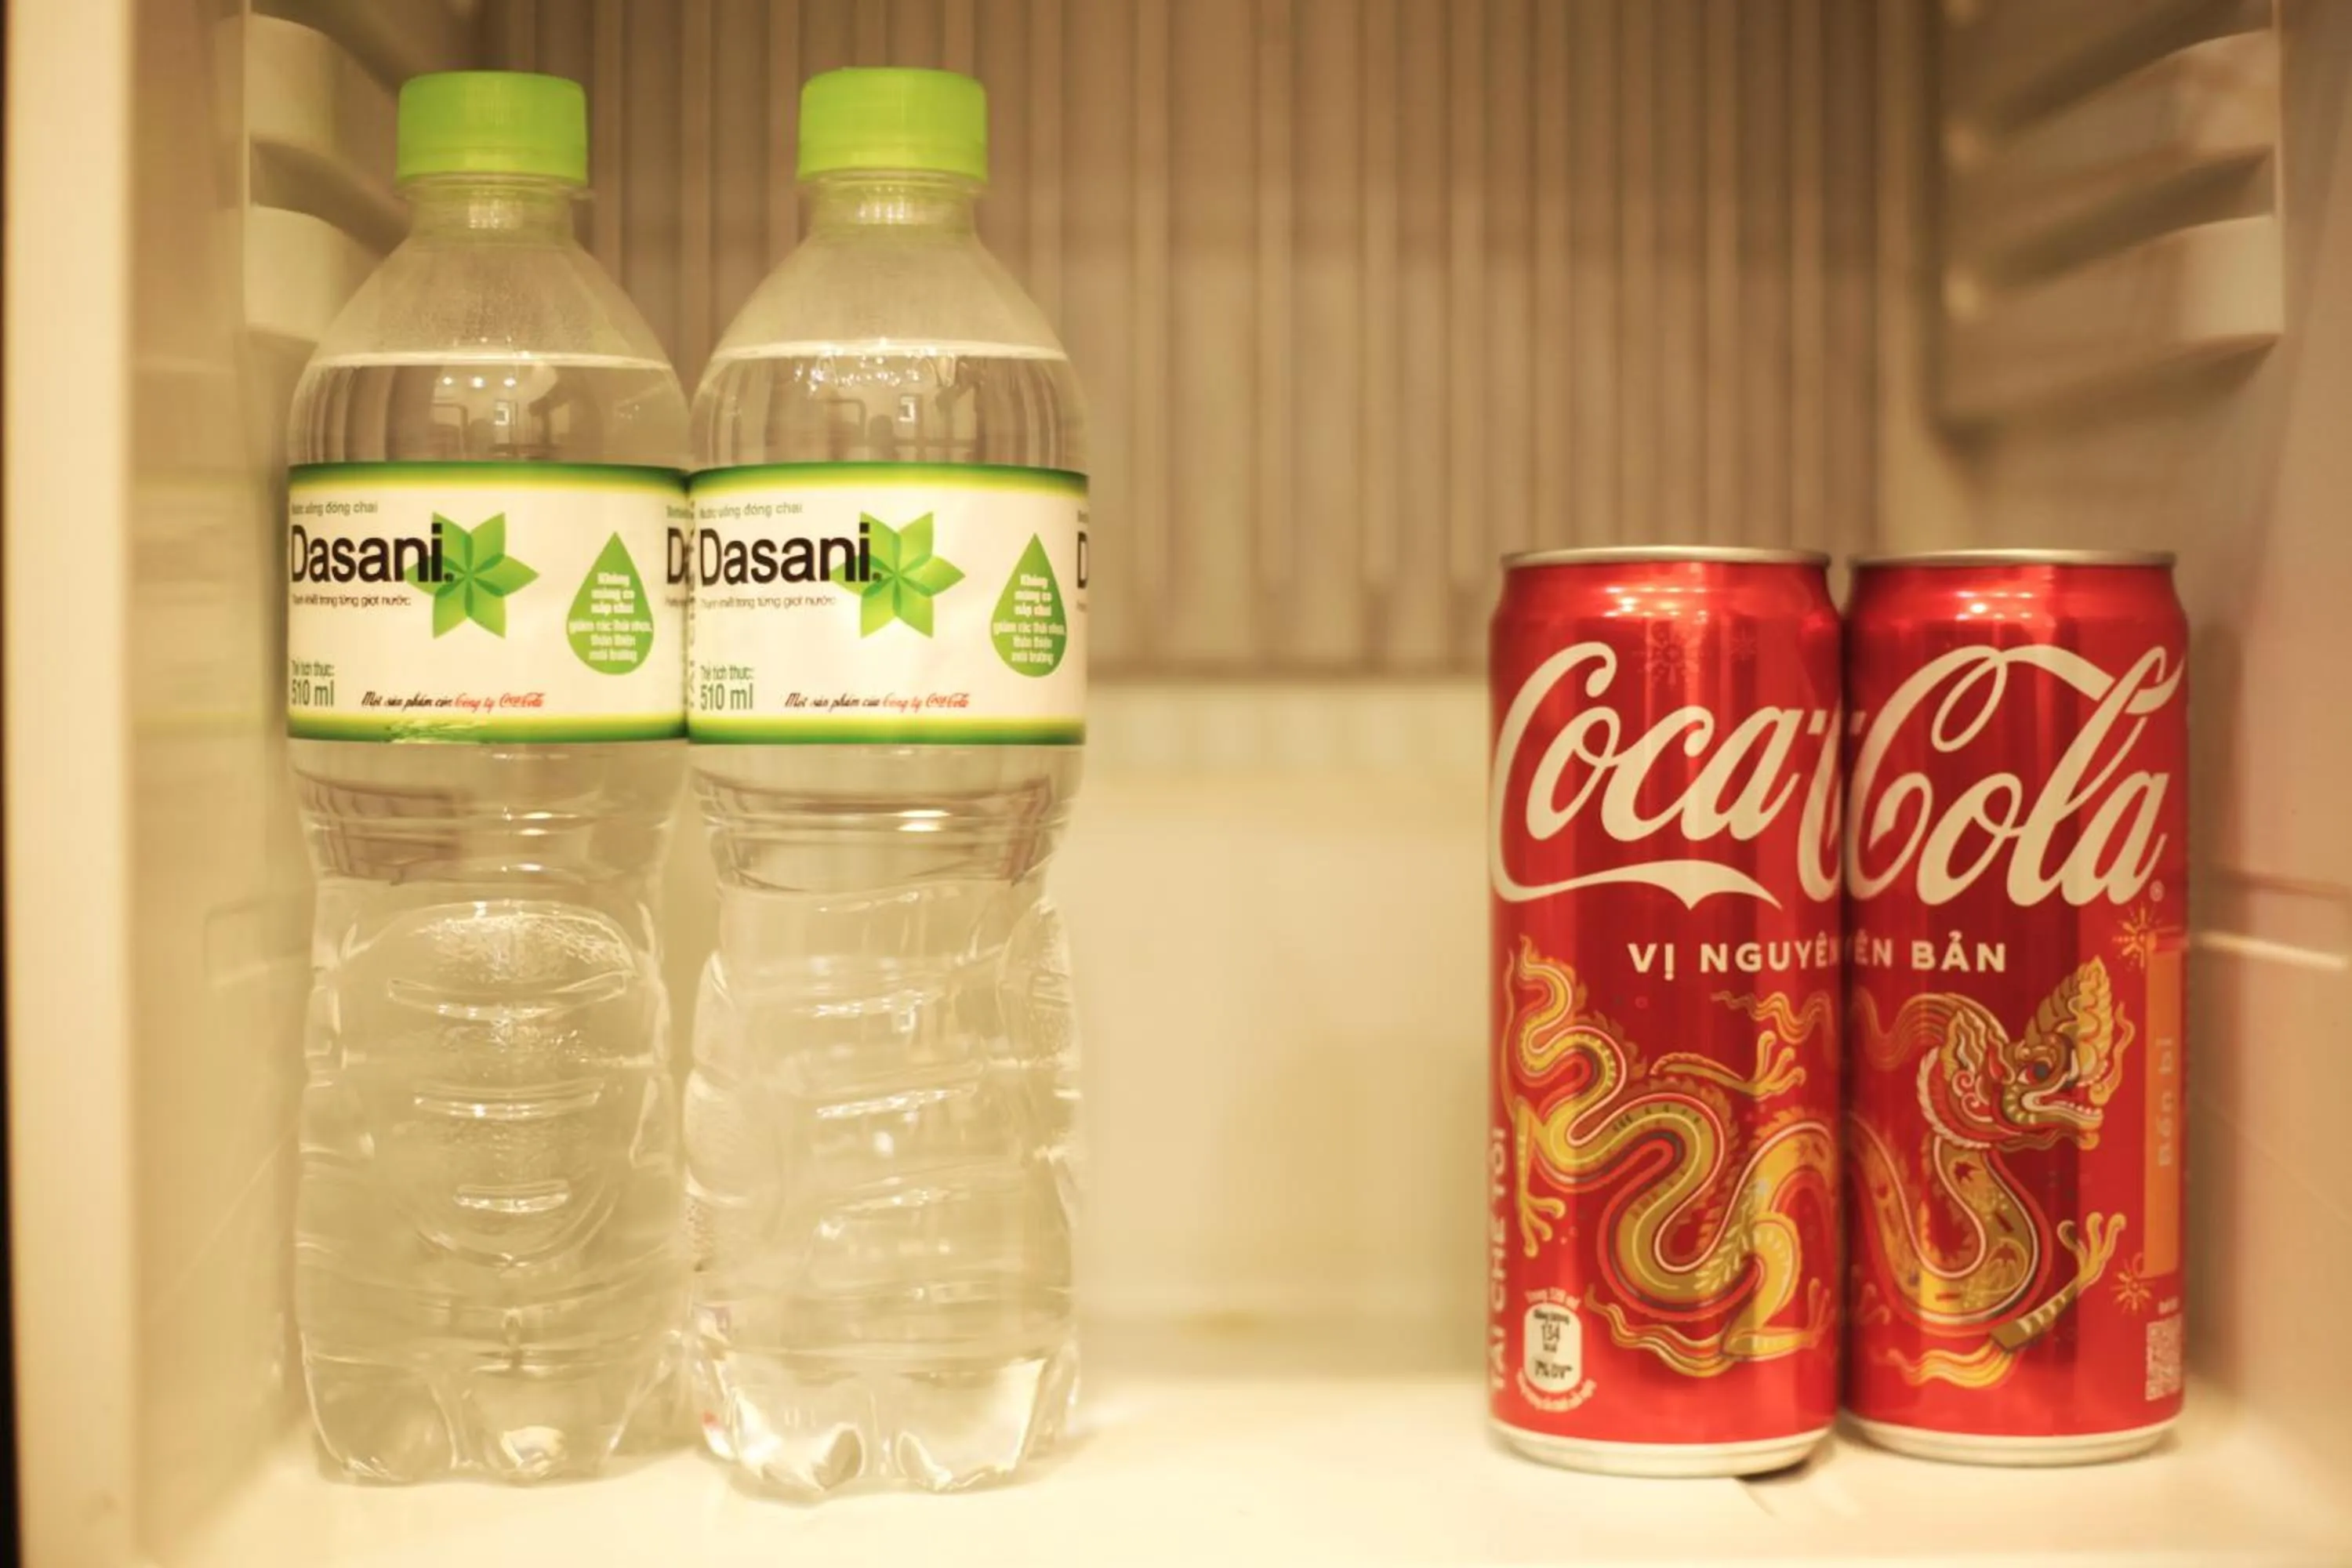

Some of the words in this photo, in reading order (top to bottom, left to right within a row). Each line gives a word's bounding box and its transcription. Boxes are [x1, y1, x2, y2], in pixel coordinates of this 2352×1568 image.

[353, 499, 378, 514] chai
[775, 500, 803, 514] chai
[291, 522, 443, 583] Dasani
[699, 521, 870, 587] Dasani
[292, 678, 310, 706] 510
[314, 679, 335, 707] ml
[700, 683, 725, 710] 510
[730, 682, 753, 710] ml
[1627, 943, 1675, 981] VỊ
[1911, 930, 2007, 972] BẢN
